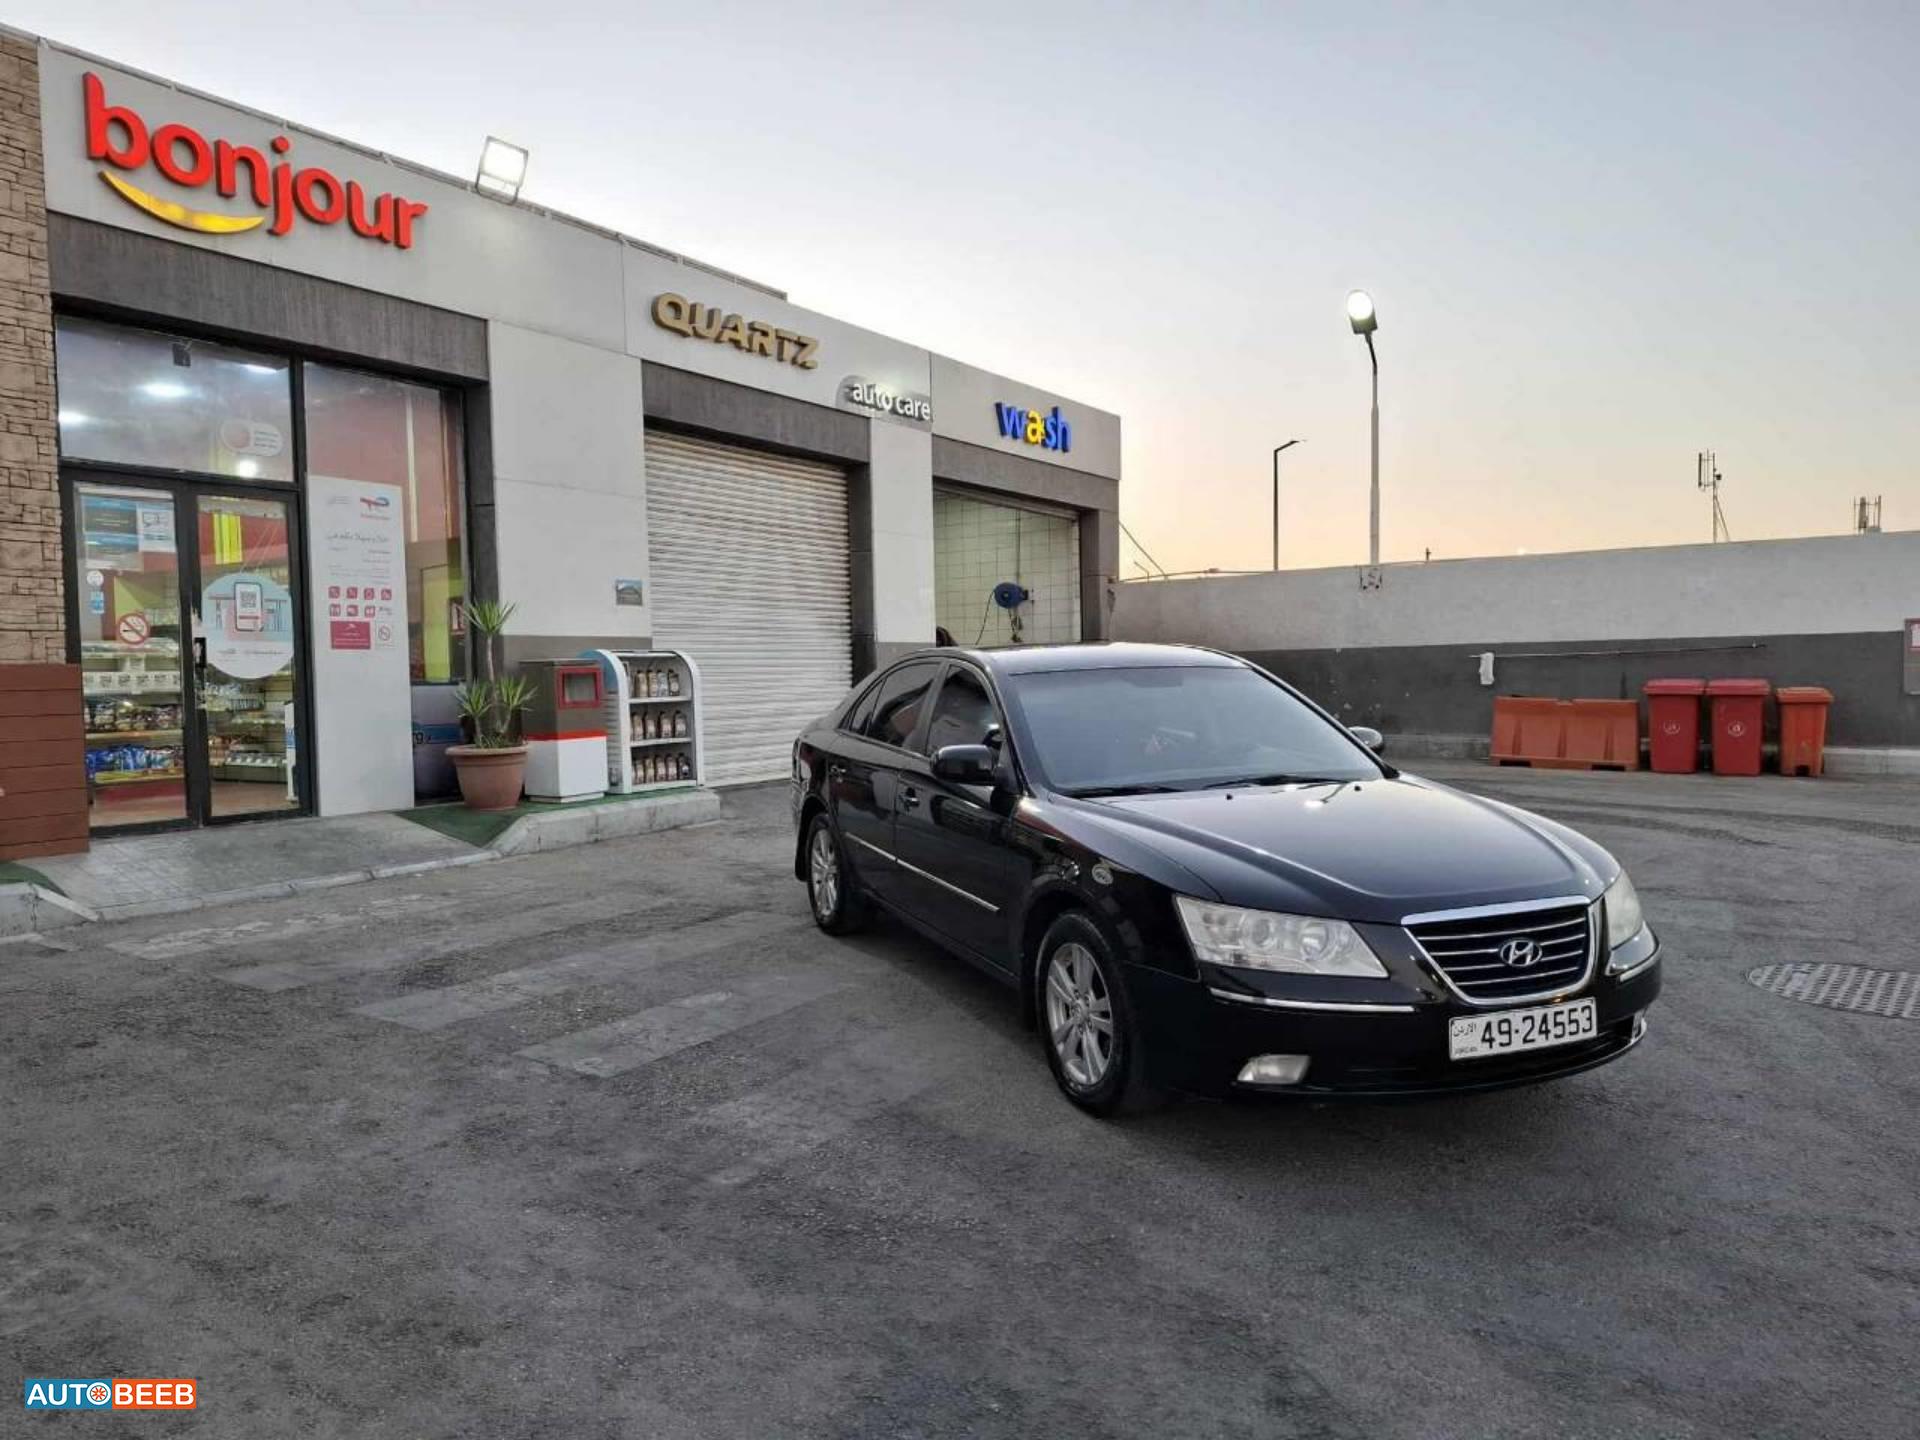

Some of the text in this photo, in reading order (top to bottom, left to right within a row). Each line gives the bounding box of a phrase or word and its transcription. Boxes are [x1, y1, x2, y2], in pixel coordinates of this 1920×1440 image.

[83, 71, 428, 249] bonjour
[652, 292, 818, 369] QUARTZ
[850, 382, 931, 421] auto care
[995, 402, 1071, 452] wash
